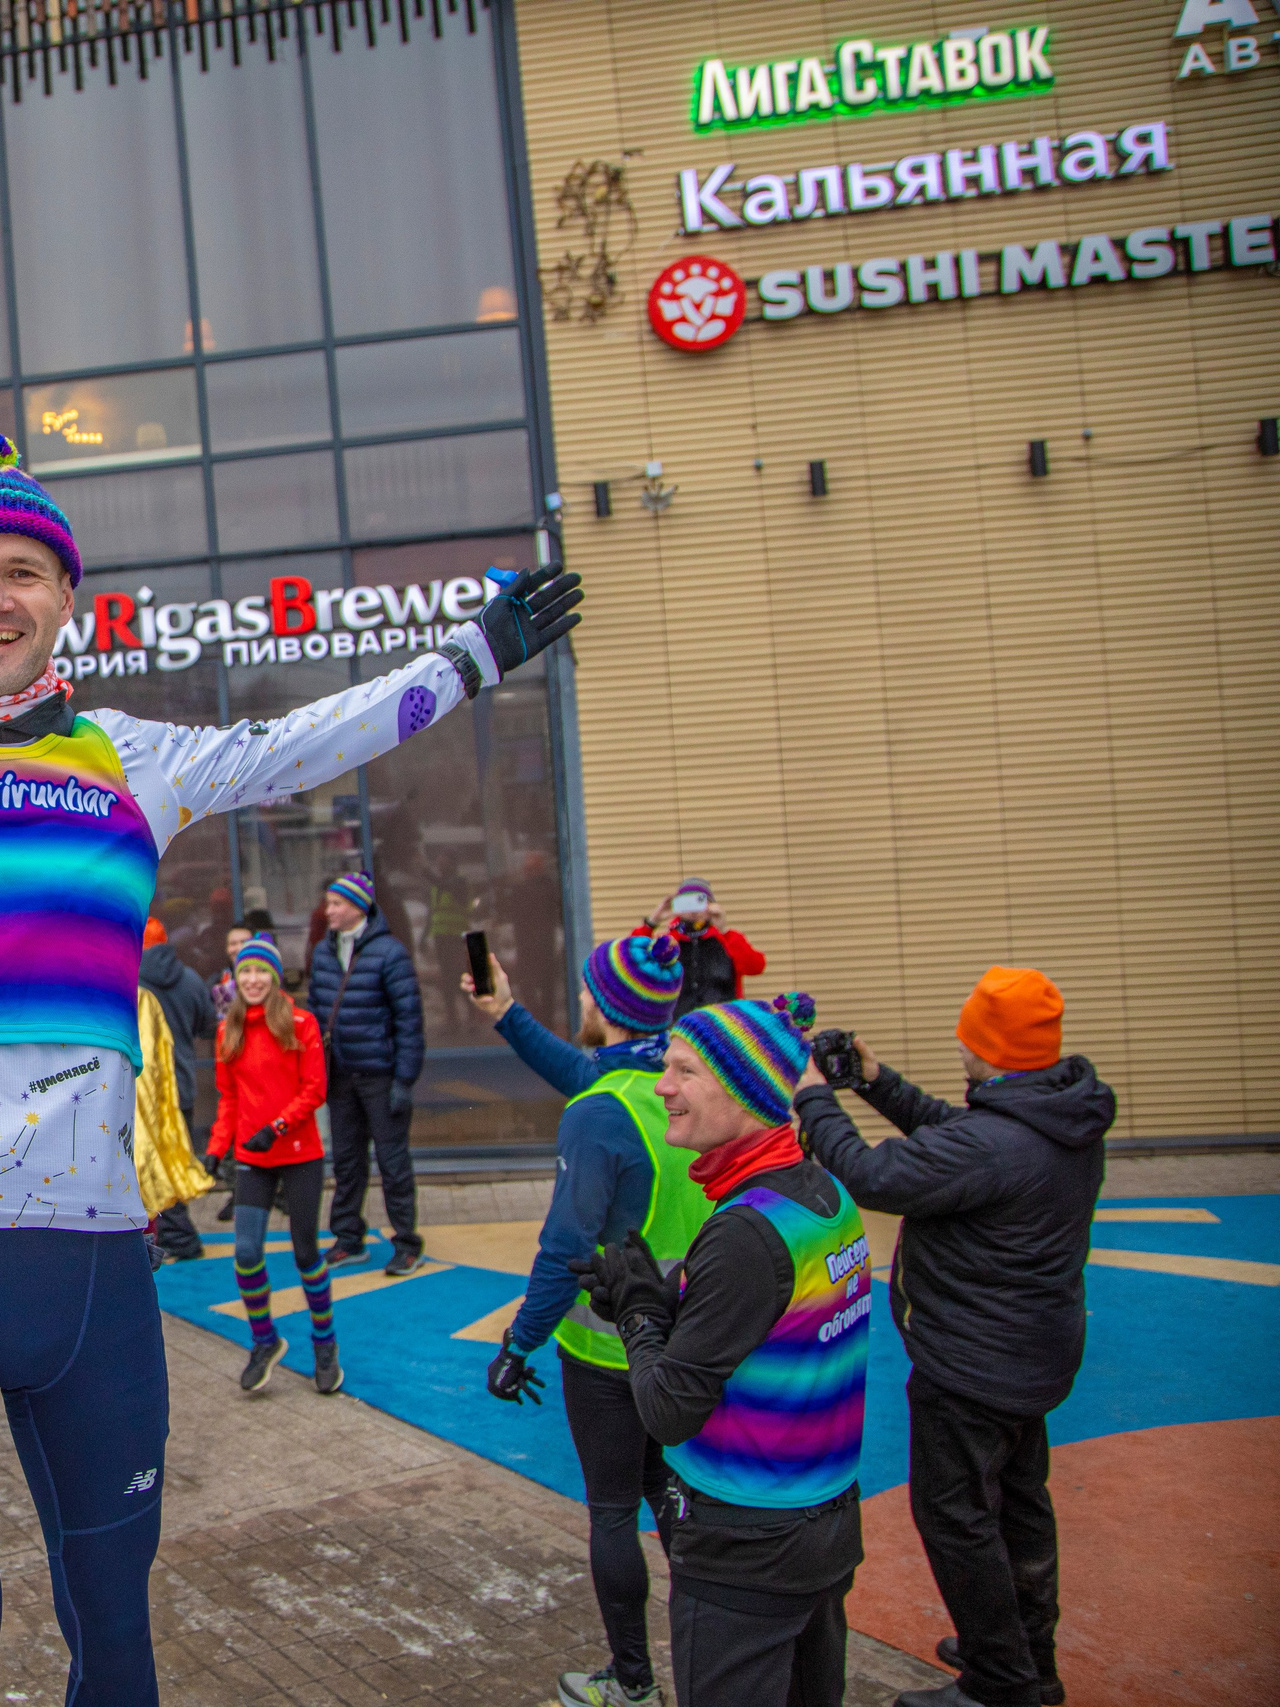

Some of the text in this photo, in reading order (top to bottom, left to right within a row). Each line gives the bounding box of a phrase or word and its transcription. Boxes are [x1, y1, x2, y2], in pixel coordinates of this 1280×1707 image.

[678, 120, 1172, 234] Кальянная
[757, 214, 1278, 320] SUSHI MASTE
